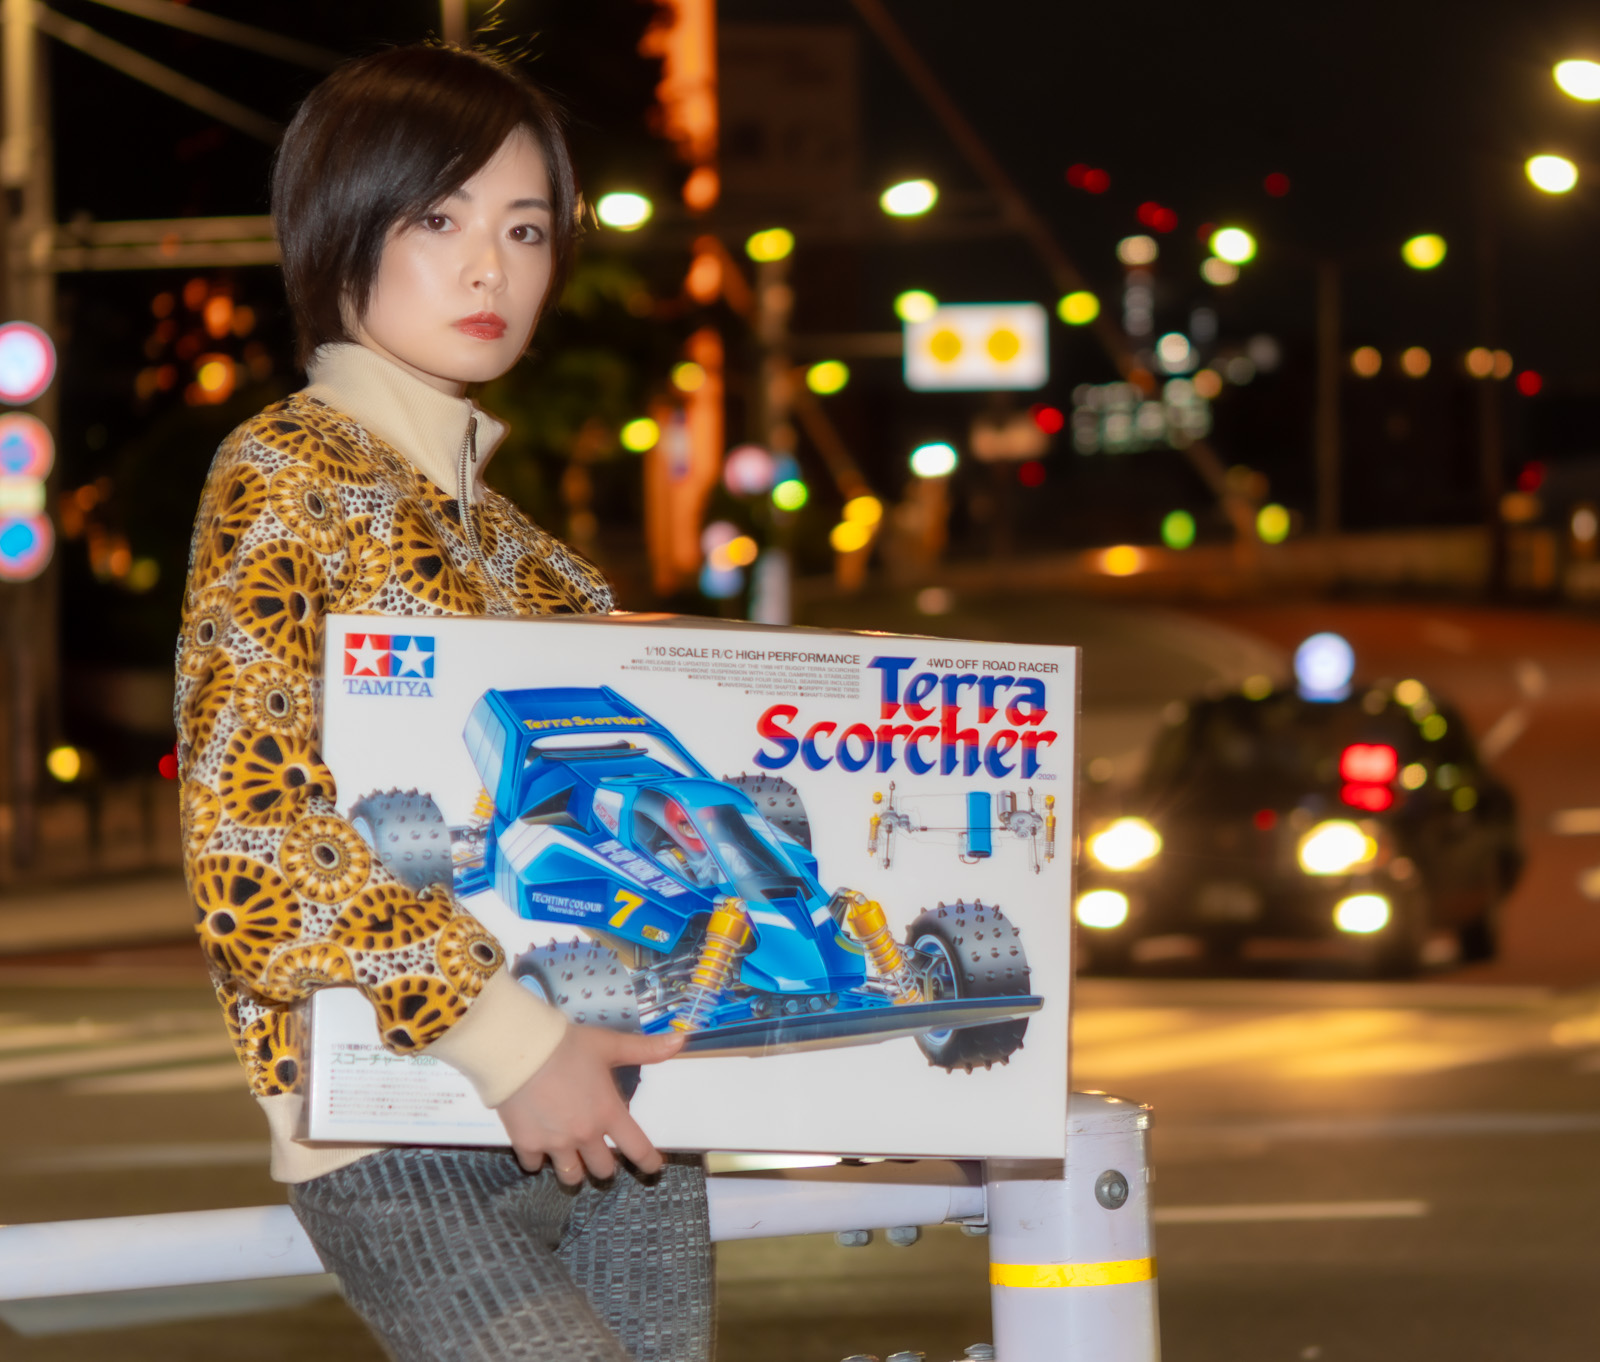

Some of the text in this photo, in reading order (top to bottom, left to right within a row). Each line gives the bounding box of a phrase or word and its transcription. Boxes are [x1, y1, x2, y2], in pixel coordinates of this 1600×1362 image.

[645, 646, 860, 664] 1/10 SCALE R/C HIGH PERFORMANCE
[926, 658, 1059, 674] 4WD OFF ROAD RACER
[343, 678, 434, 697] TAMIYA
[866, 656, 1048, 727] Terra
[522, 716, 647, 730] Terra Scorcher
[752, 704, 1058, 780] Scorcher
[648, 877, 688, 898] TEAM
[532, 892, 603, 913] TECHTINT COLOUR
[608, 889, 644, 928] 7
[330, 1052, 405, 1066] スコーチャー
